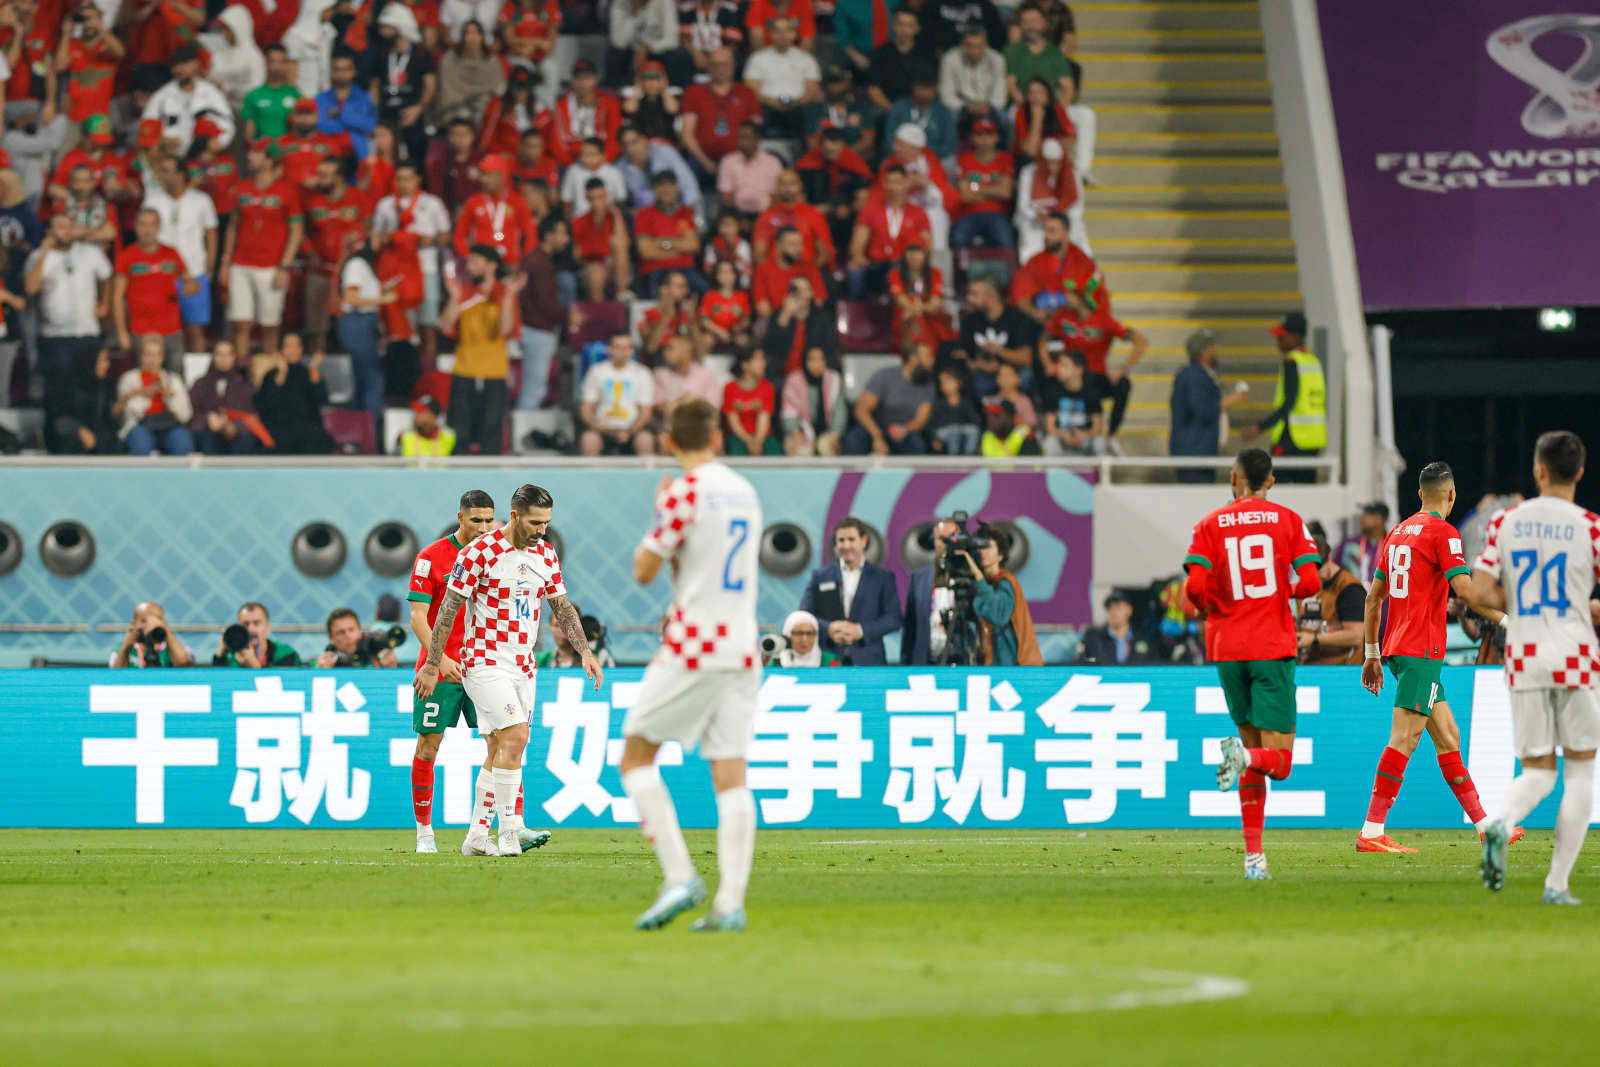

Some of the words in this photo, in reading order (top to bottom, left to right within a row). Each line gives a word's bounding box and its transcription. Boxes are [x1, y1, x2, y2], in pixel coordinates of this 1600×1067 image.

[1376, 152, 1483, 171] FIFA
[1218, 511, 1279, 528] EN-NESYRI
[723, 519, 748, 591] 2
[1224, 533, 1278, 601] 19
[1388, 544, 1412, 599] 18
[1511, 549, 1571, 618] 24
[515, 598, 530, 620] 14
[422, 702, 440, 728] 2
